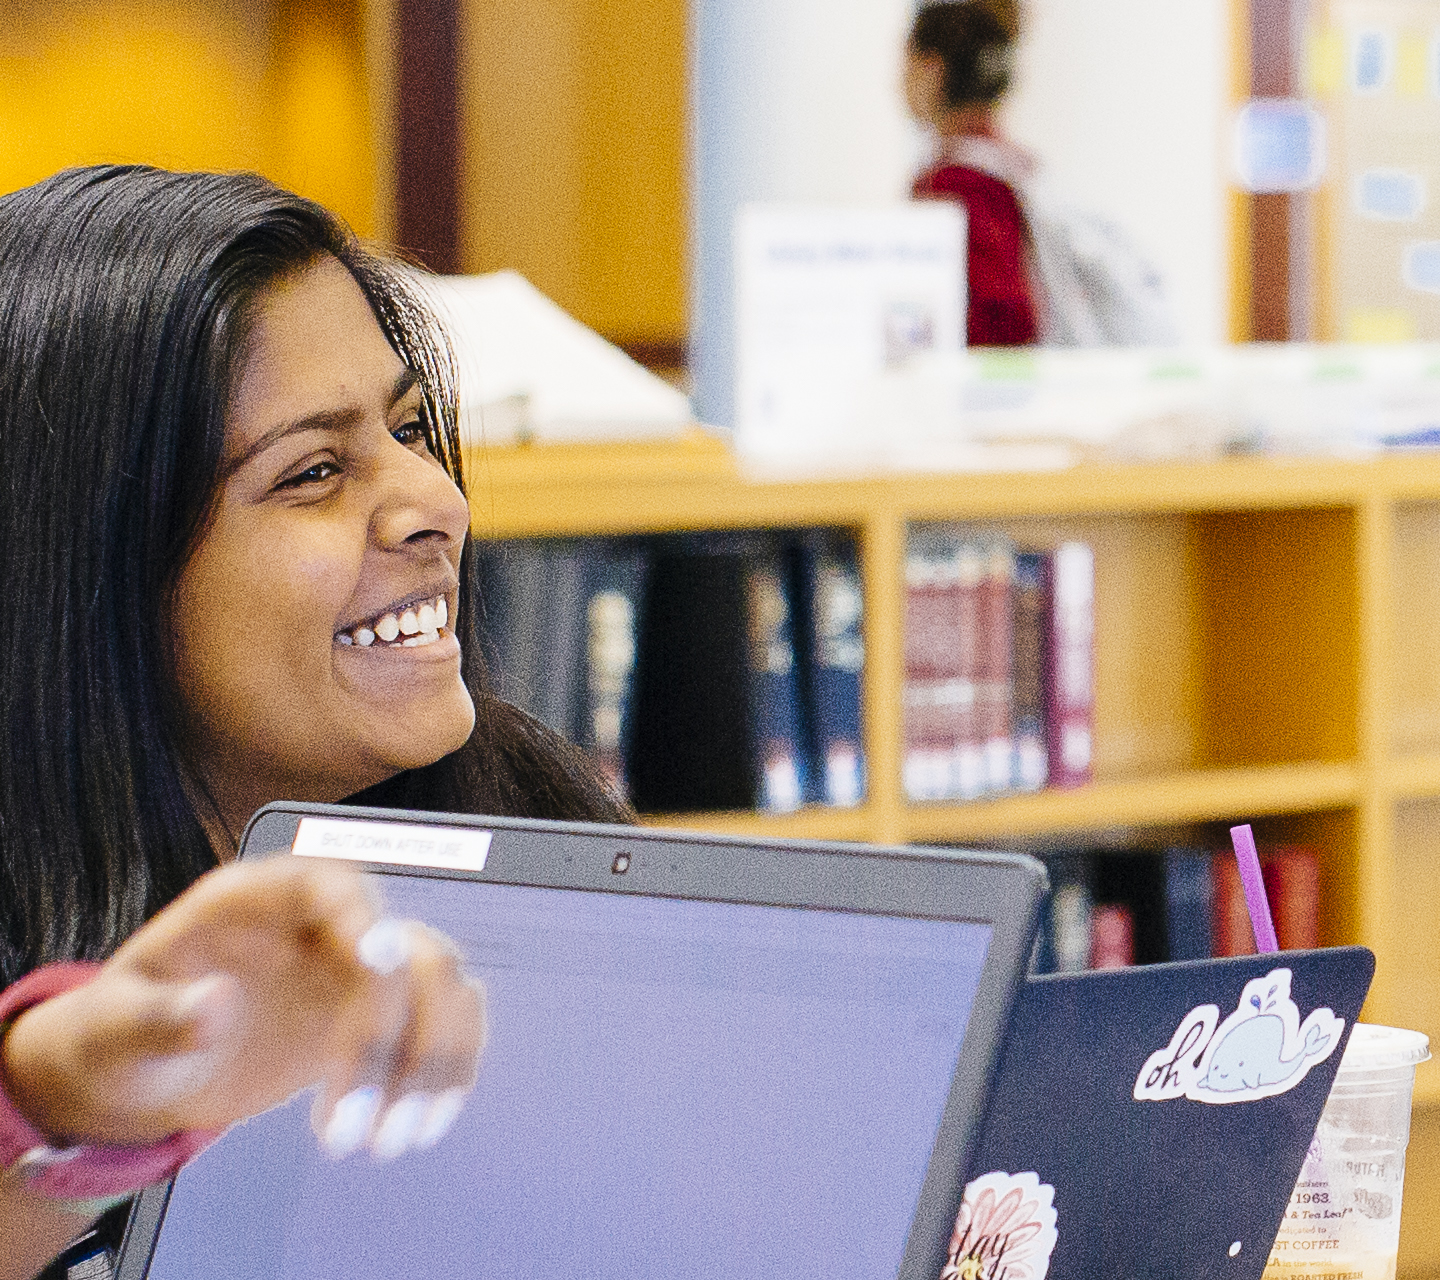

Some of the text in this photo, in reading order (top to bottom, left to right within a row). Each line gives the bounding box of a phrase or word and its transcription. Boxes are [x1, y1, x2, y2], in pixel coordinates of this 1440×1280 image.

[321, 832, 464, 857] SHUT DOWN AFTER USE
[1145, 1020, 1204, 1089] oh
[1302, 1210, 1321, 1219] Tea
[1279, 1225, 1316, 1235] edicated
[1292, 1239, 1340, 1250] COFFEE
